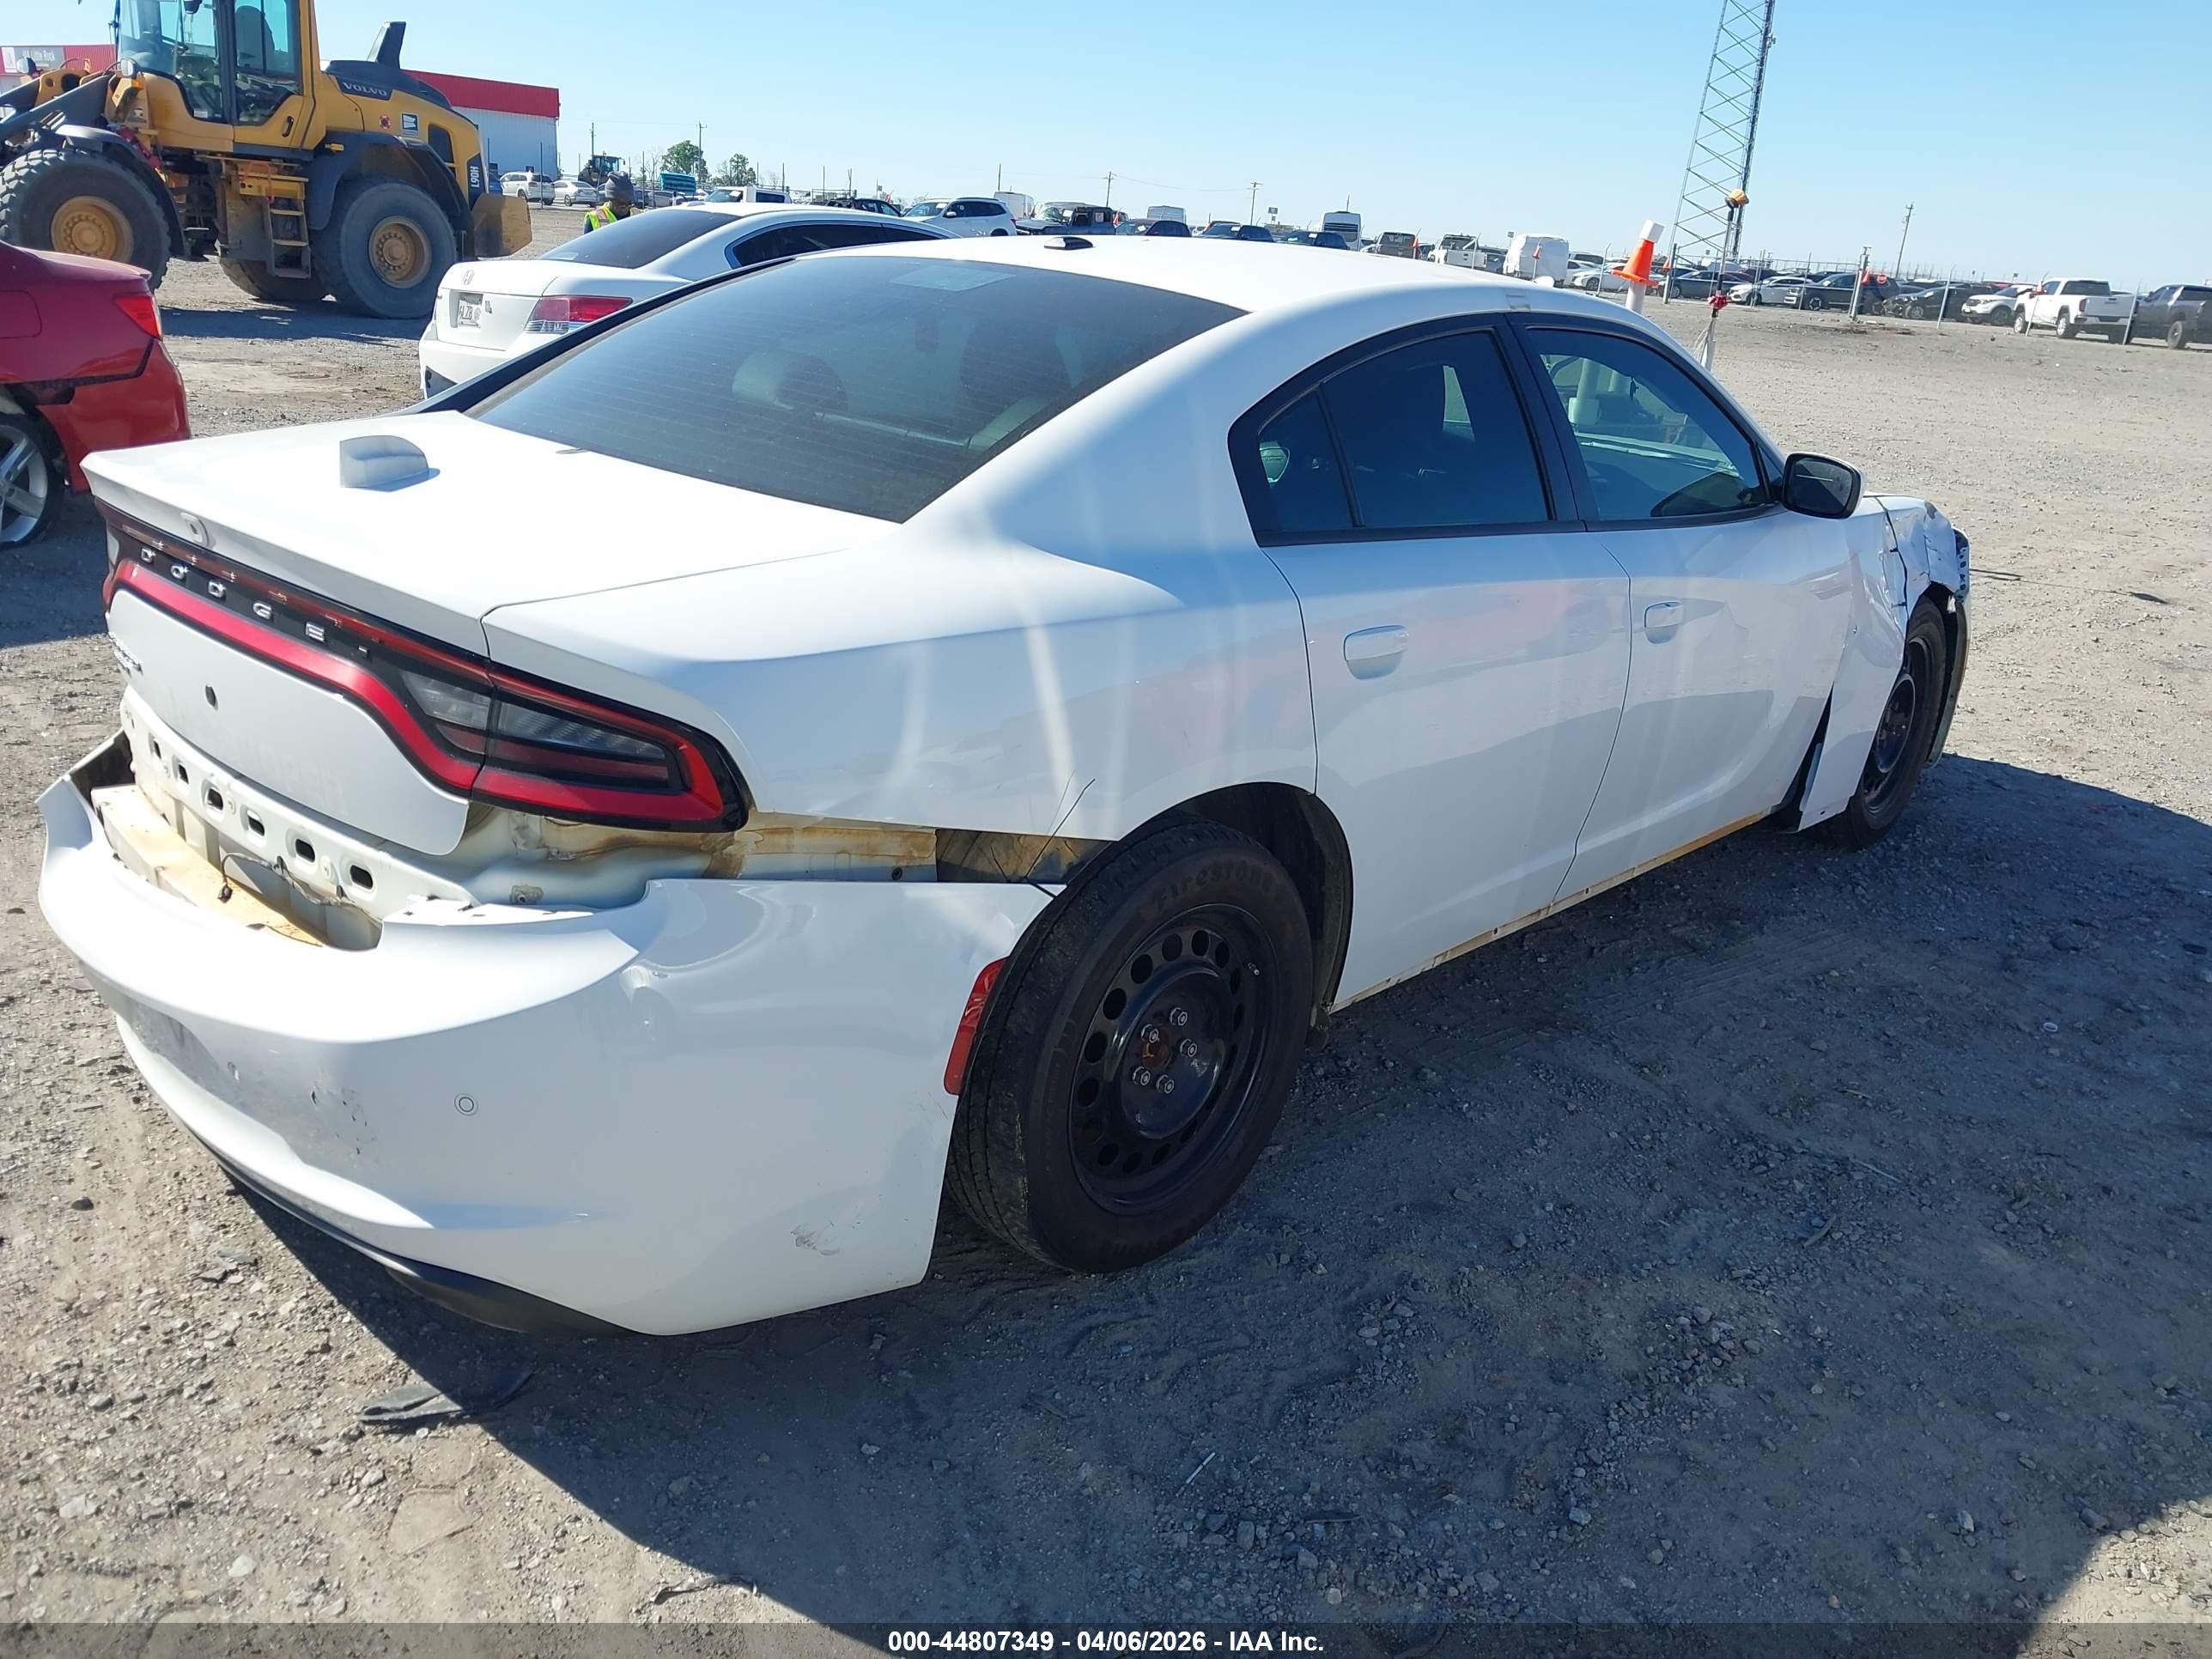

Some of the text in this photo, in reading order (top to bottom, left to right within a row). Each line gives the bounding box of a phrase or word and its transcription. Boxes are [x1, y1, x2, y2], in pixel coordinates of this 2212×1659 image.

[342, 82, 387, 96] VOLVO
[470, 166, 480, 188] L90H
[141, 546, 325, 643] DODGE
